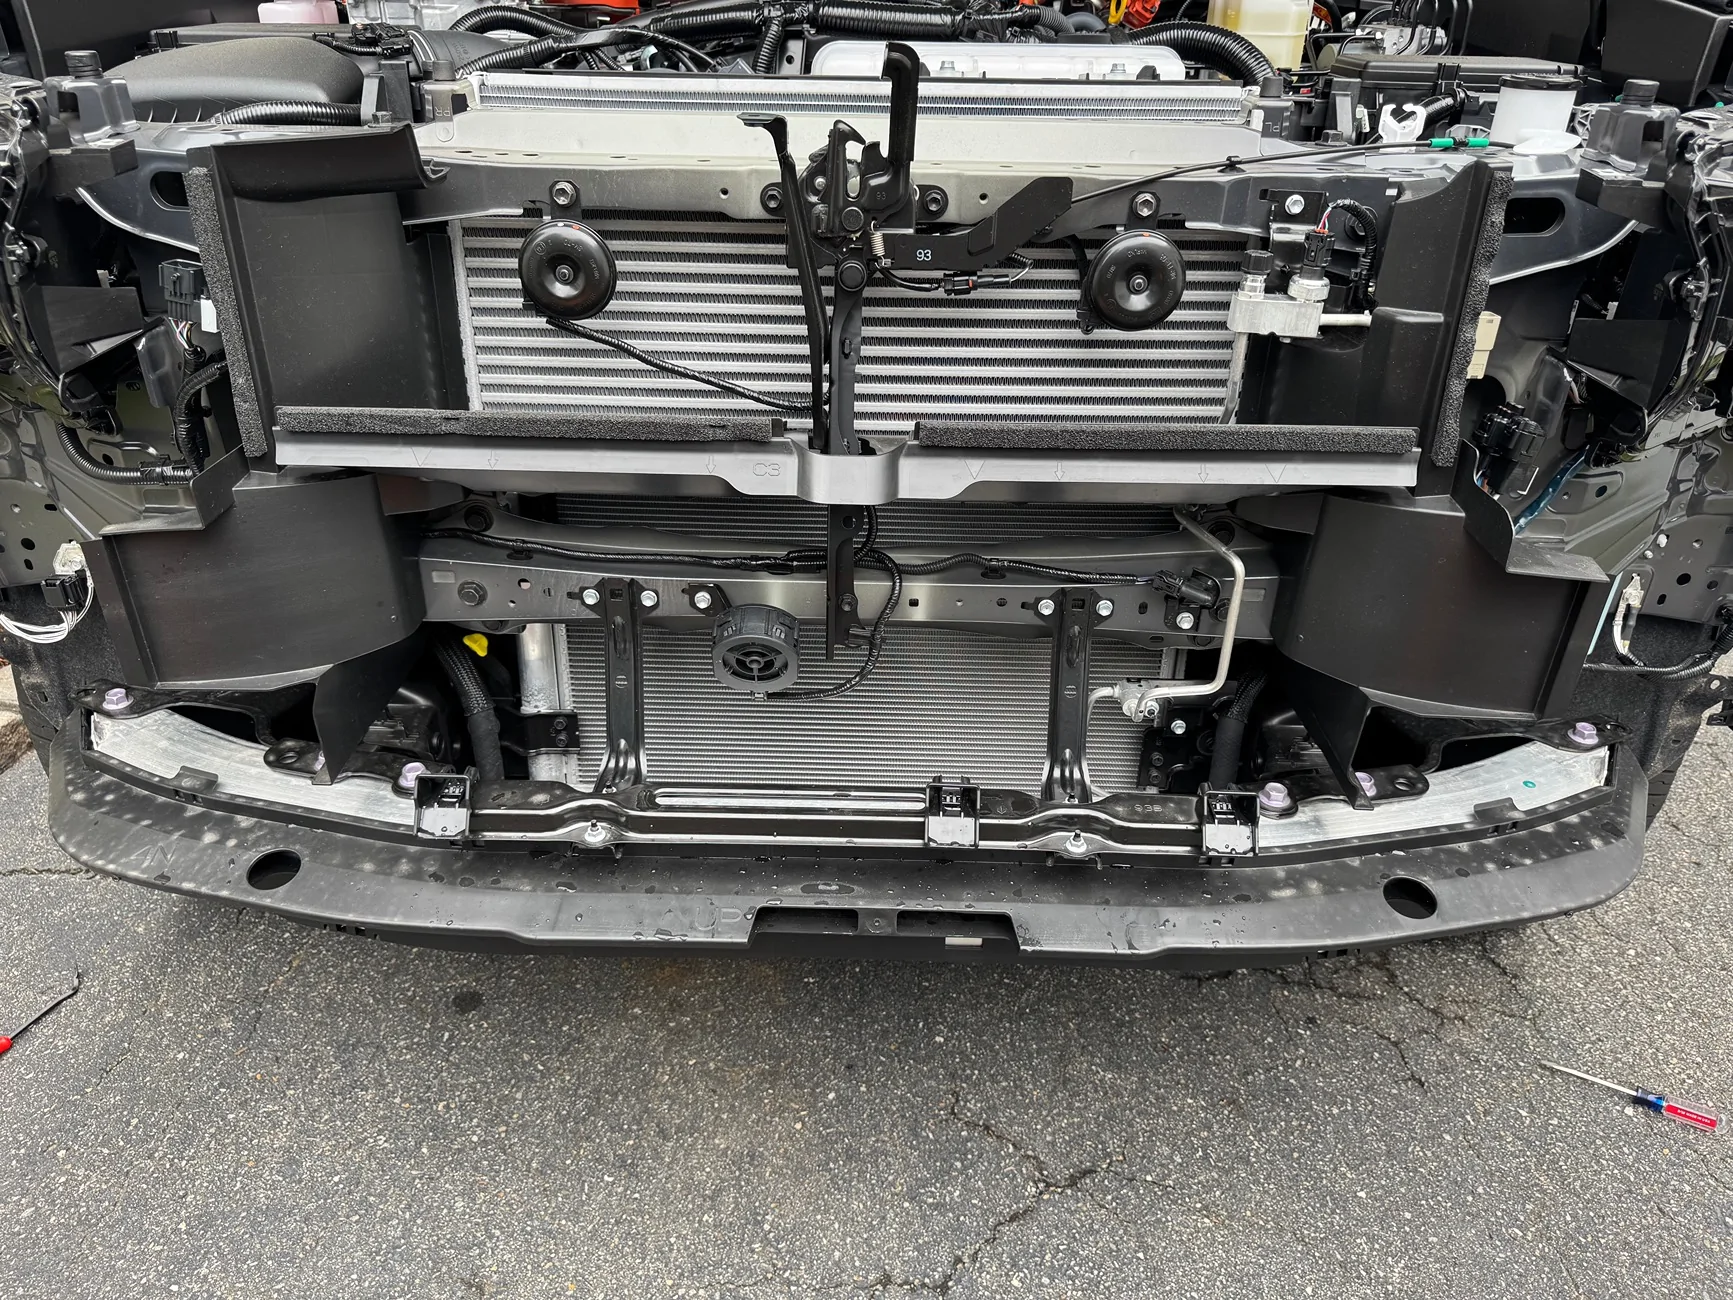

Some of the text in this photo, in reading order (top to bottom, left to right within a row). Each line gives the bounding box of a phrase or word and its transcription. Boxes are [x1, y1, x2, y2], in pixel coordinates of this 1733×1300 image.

[434, 106, 451, 117] PR
[1264, 121, 1281, 133] PL
[875, 191, 887, 201] 93
[916, 249, 932, 261] 93
[752, 462, 781, 477] C3
[695, 906, 742, 931] UP
